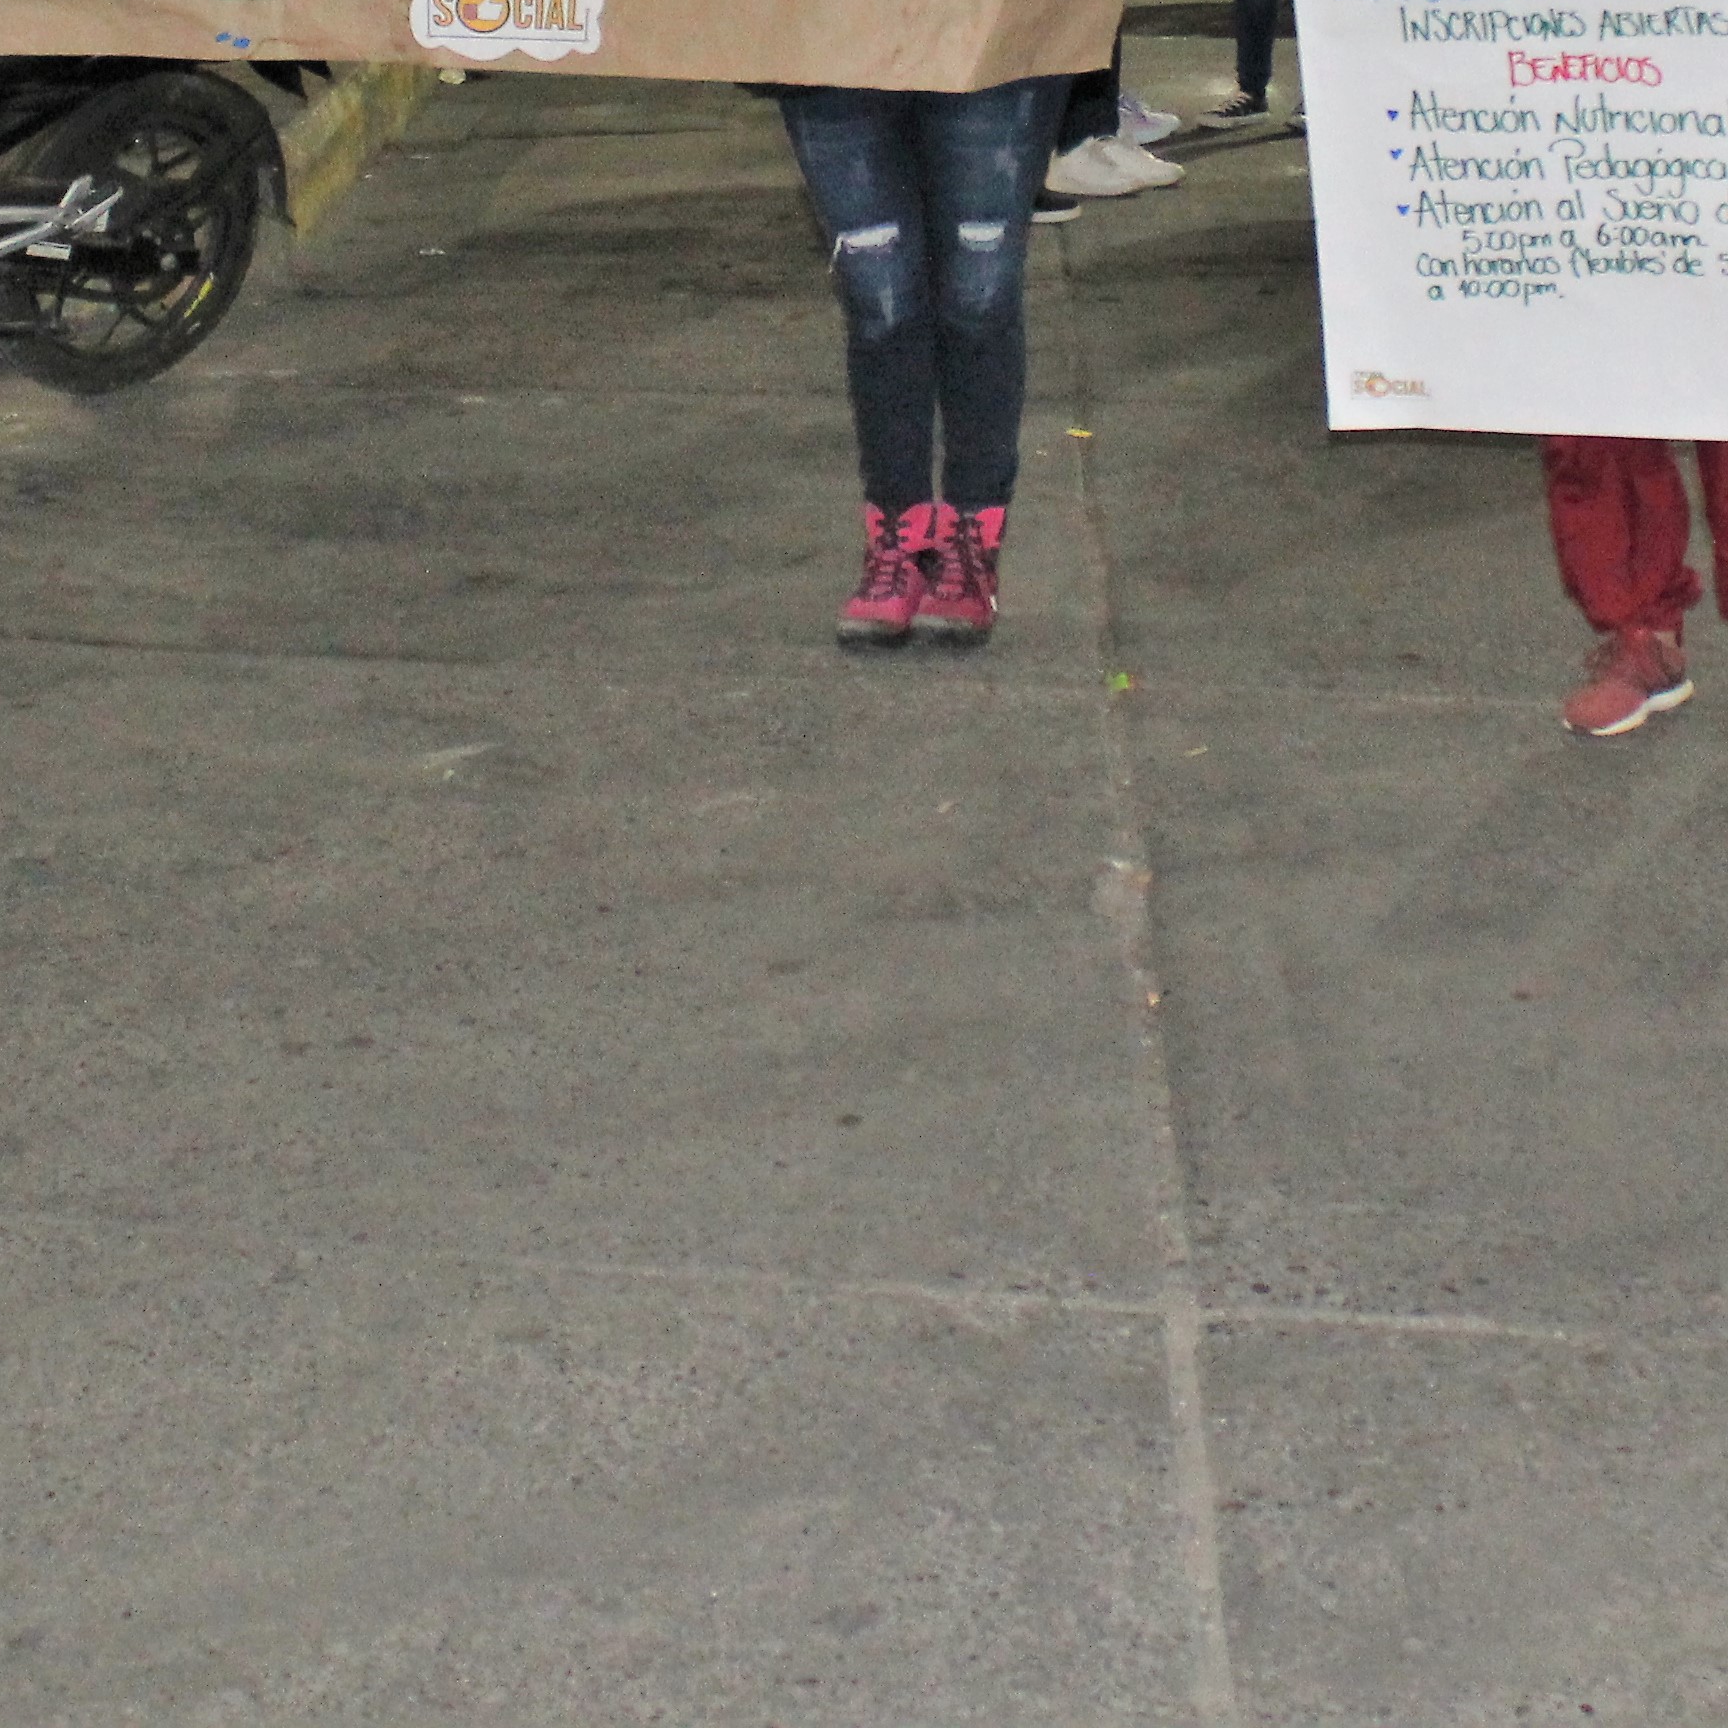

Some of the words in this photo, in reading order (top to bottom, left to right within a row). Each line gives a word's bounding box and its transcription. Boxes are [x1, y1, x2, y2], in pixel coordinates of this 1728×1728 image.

[1508, 51, 1663, 89] BENEFICIOS
[1408, 90, 1541, 136] Atención
[1408, 147, 1546, 183] Atención
[1549, 139, 1728, 199] Pedagógica
[1413, 189, 1544, 230] Atención
[1557, 188, 1586, 224] al
[1599, 187, 1700, 225] Sueño
[1559, 229, 1575, 249] a
[1672, 252, 1704, 277] de
[1428, 284, 1444, 300] a
